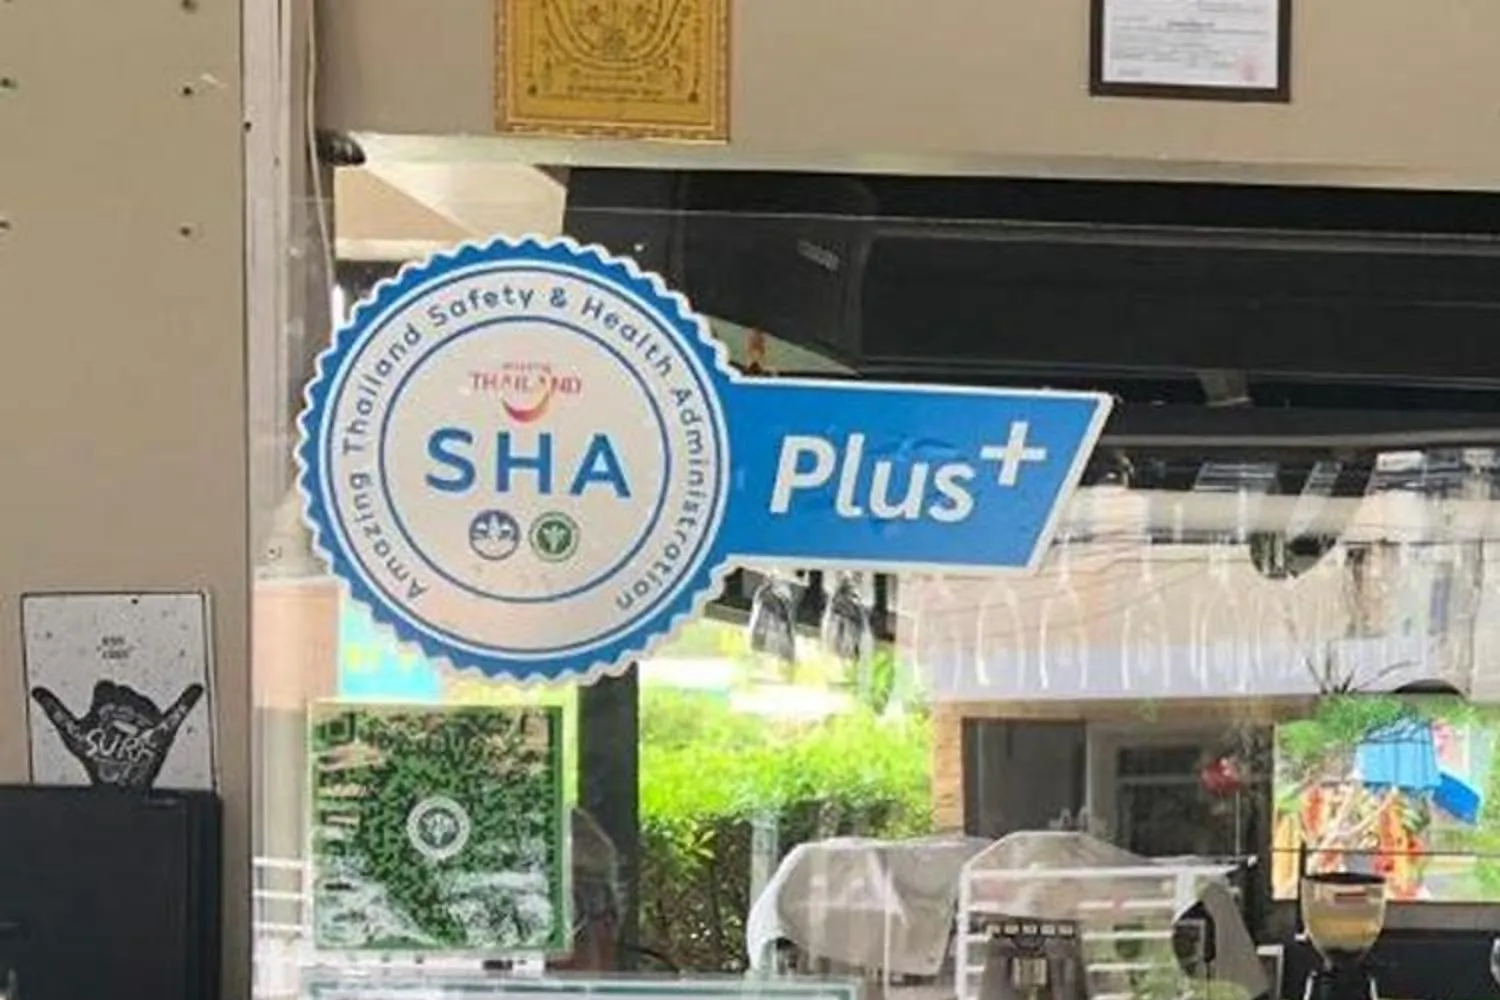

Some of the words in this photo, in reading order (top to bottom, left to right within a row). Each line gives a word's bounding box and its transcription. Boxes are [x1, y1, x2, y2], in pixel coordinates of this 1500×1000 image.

[429, 284, 535, 329] Safety
[549, 286, 568, 308] &
[580, 294, 675, 379] Health
[344, 323, 422, 458] Thailand
[425, 426, 633, 499] SHA
[615, 385, 707, 611] Administration
[350, 471, 429, 602] Amazing
